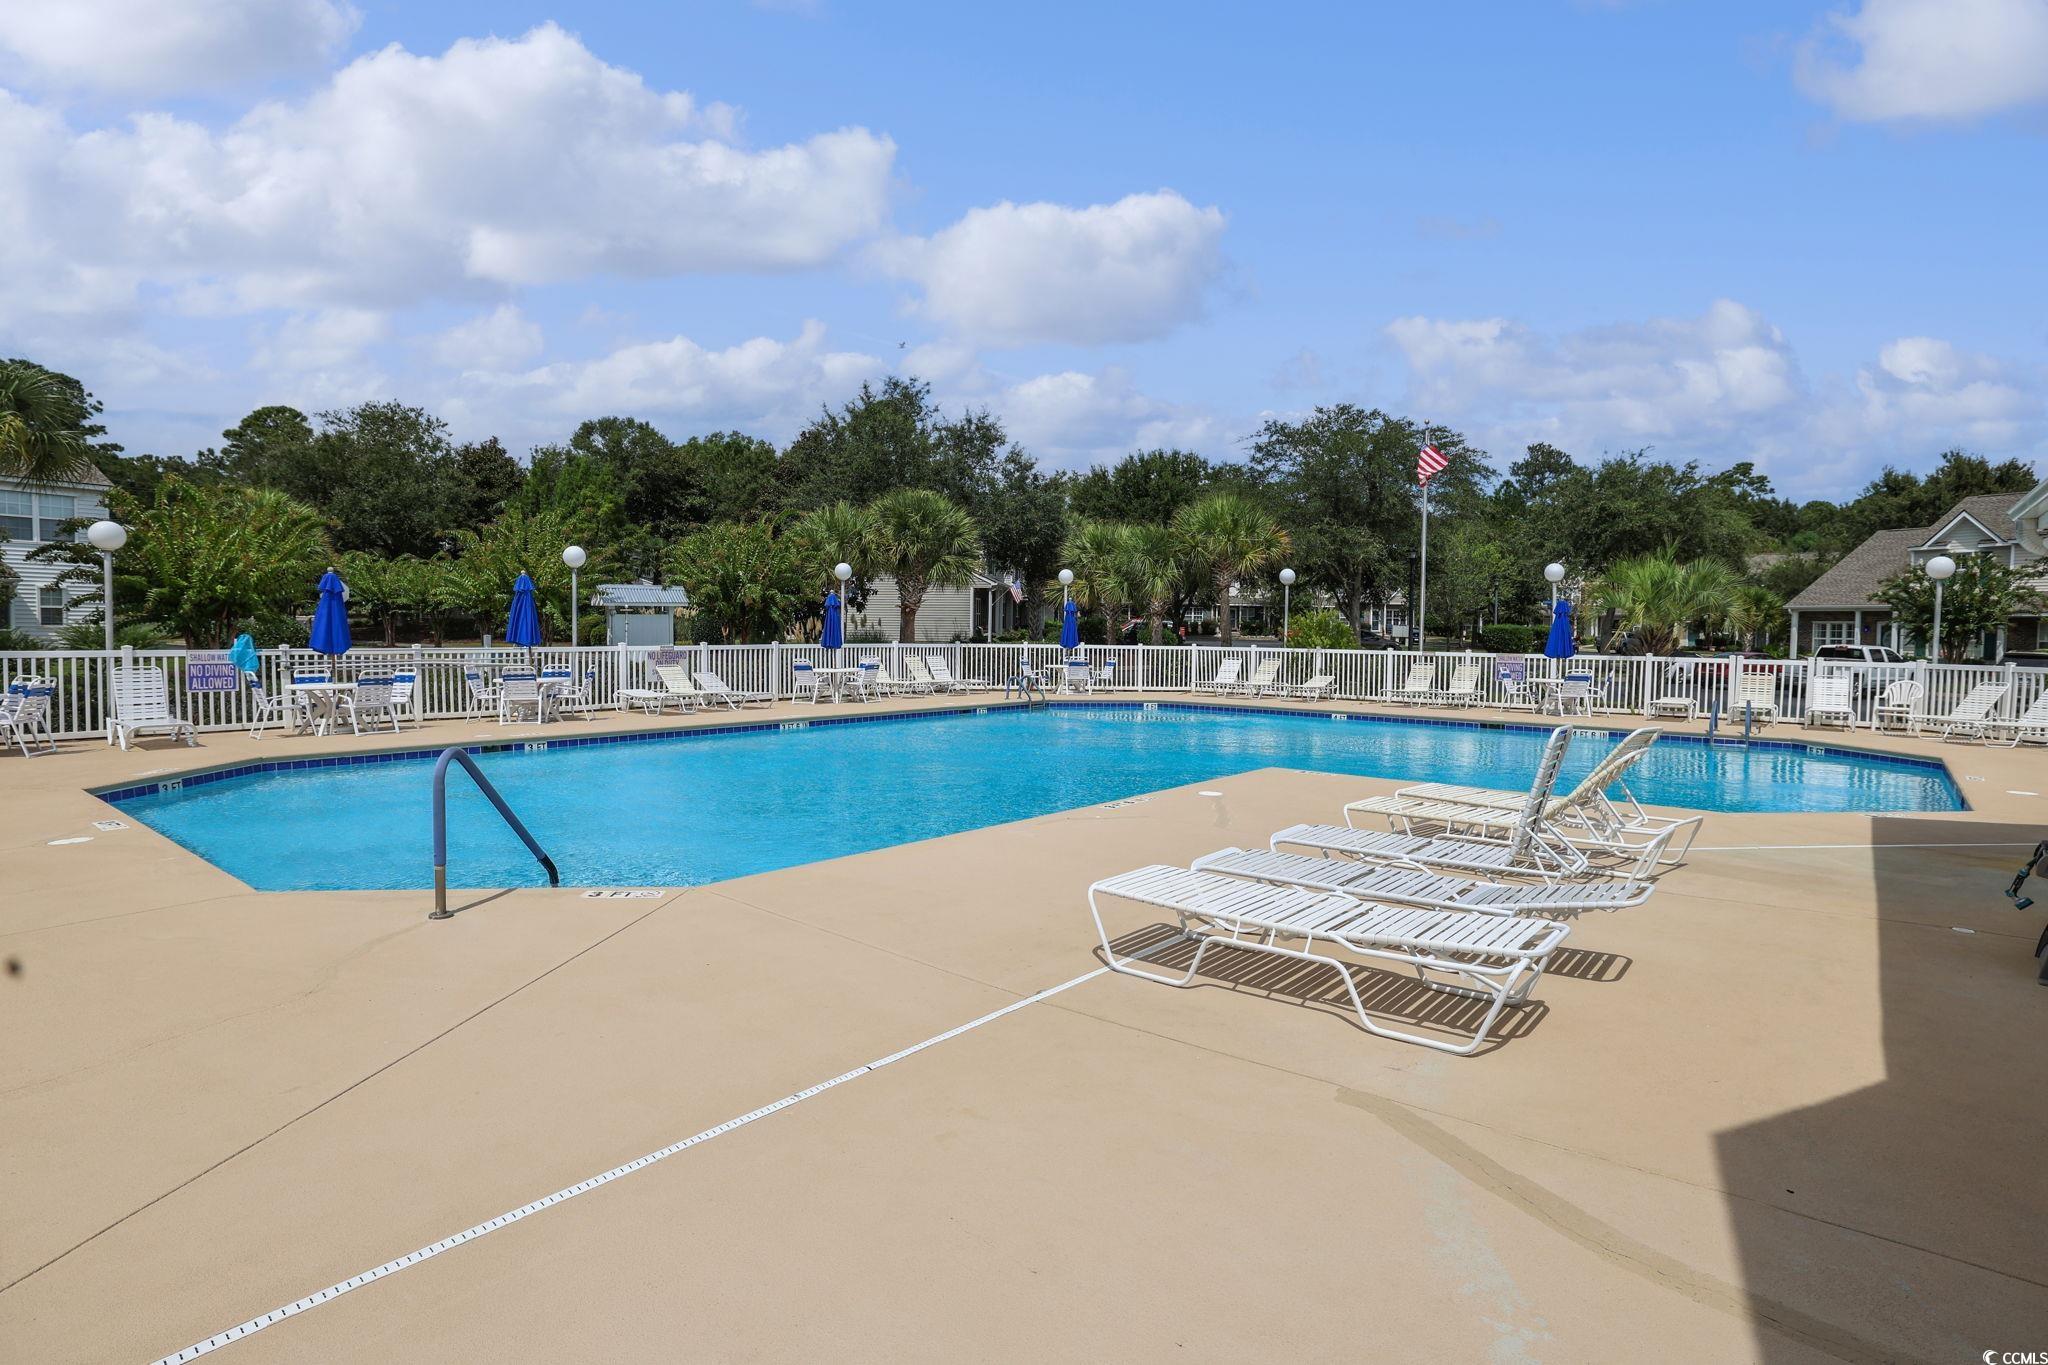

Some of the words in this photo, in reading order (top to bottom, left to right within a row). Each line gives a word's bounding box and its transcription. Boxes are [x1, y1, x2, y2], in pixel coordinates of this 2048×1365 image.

[647, 651, 656, 660] NO
[657, 650, 688, 660] LIFEGUARD
[190, 664, 203, 677] NO
[205, 664, 235, 677] DIVING
[191, 677, 234, 690] ALLOWED
